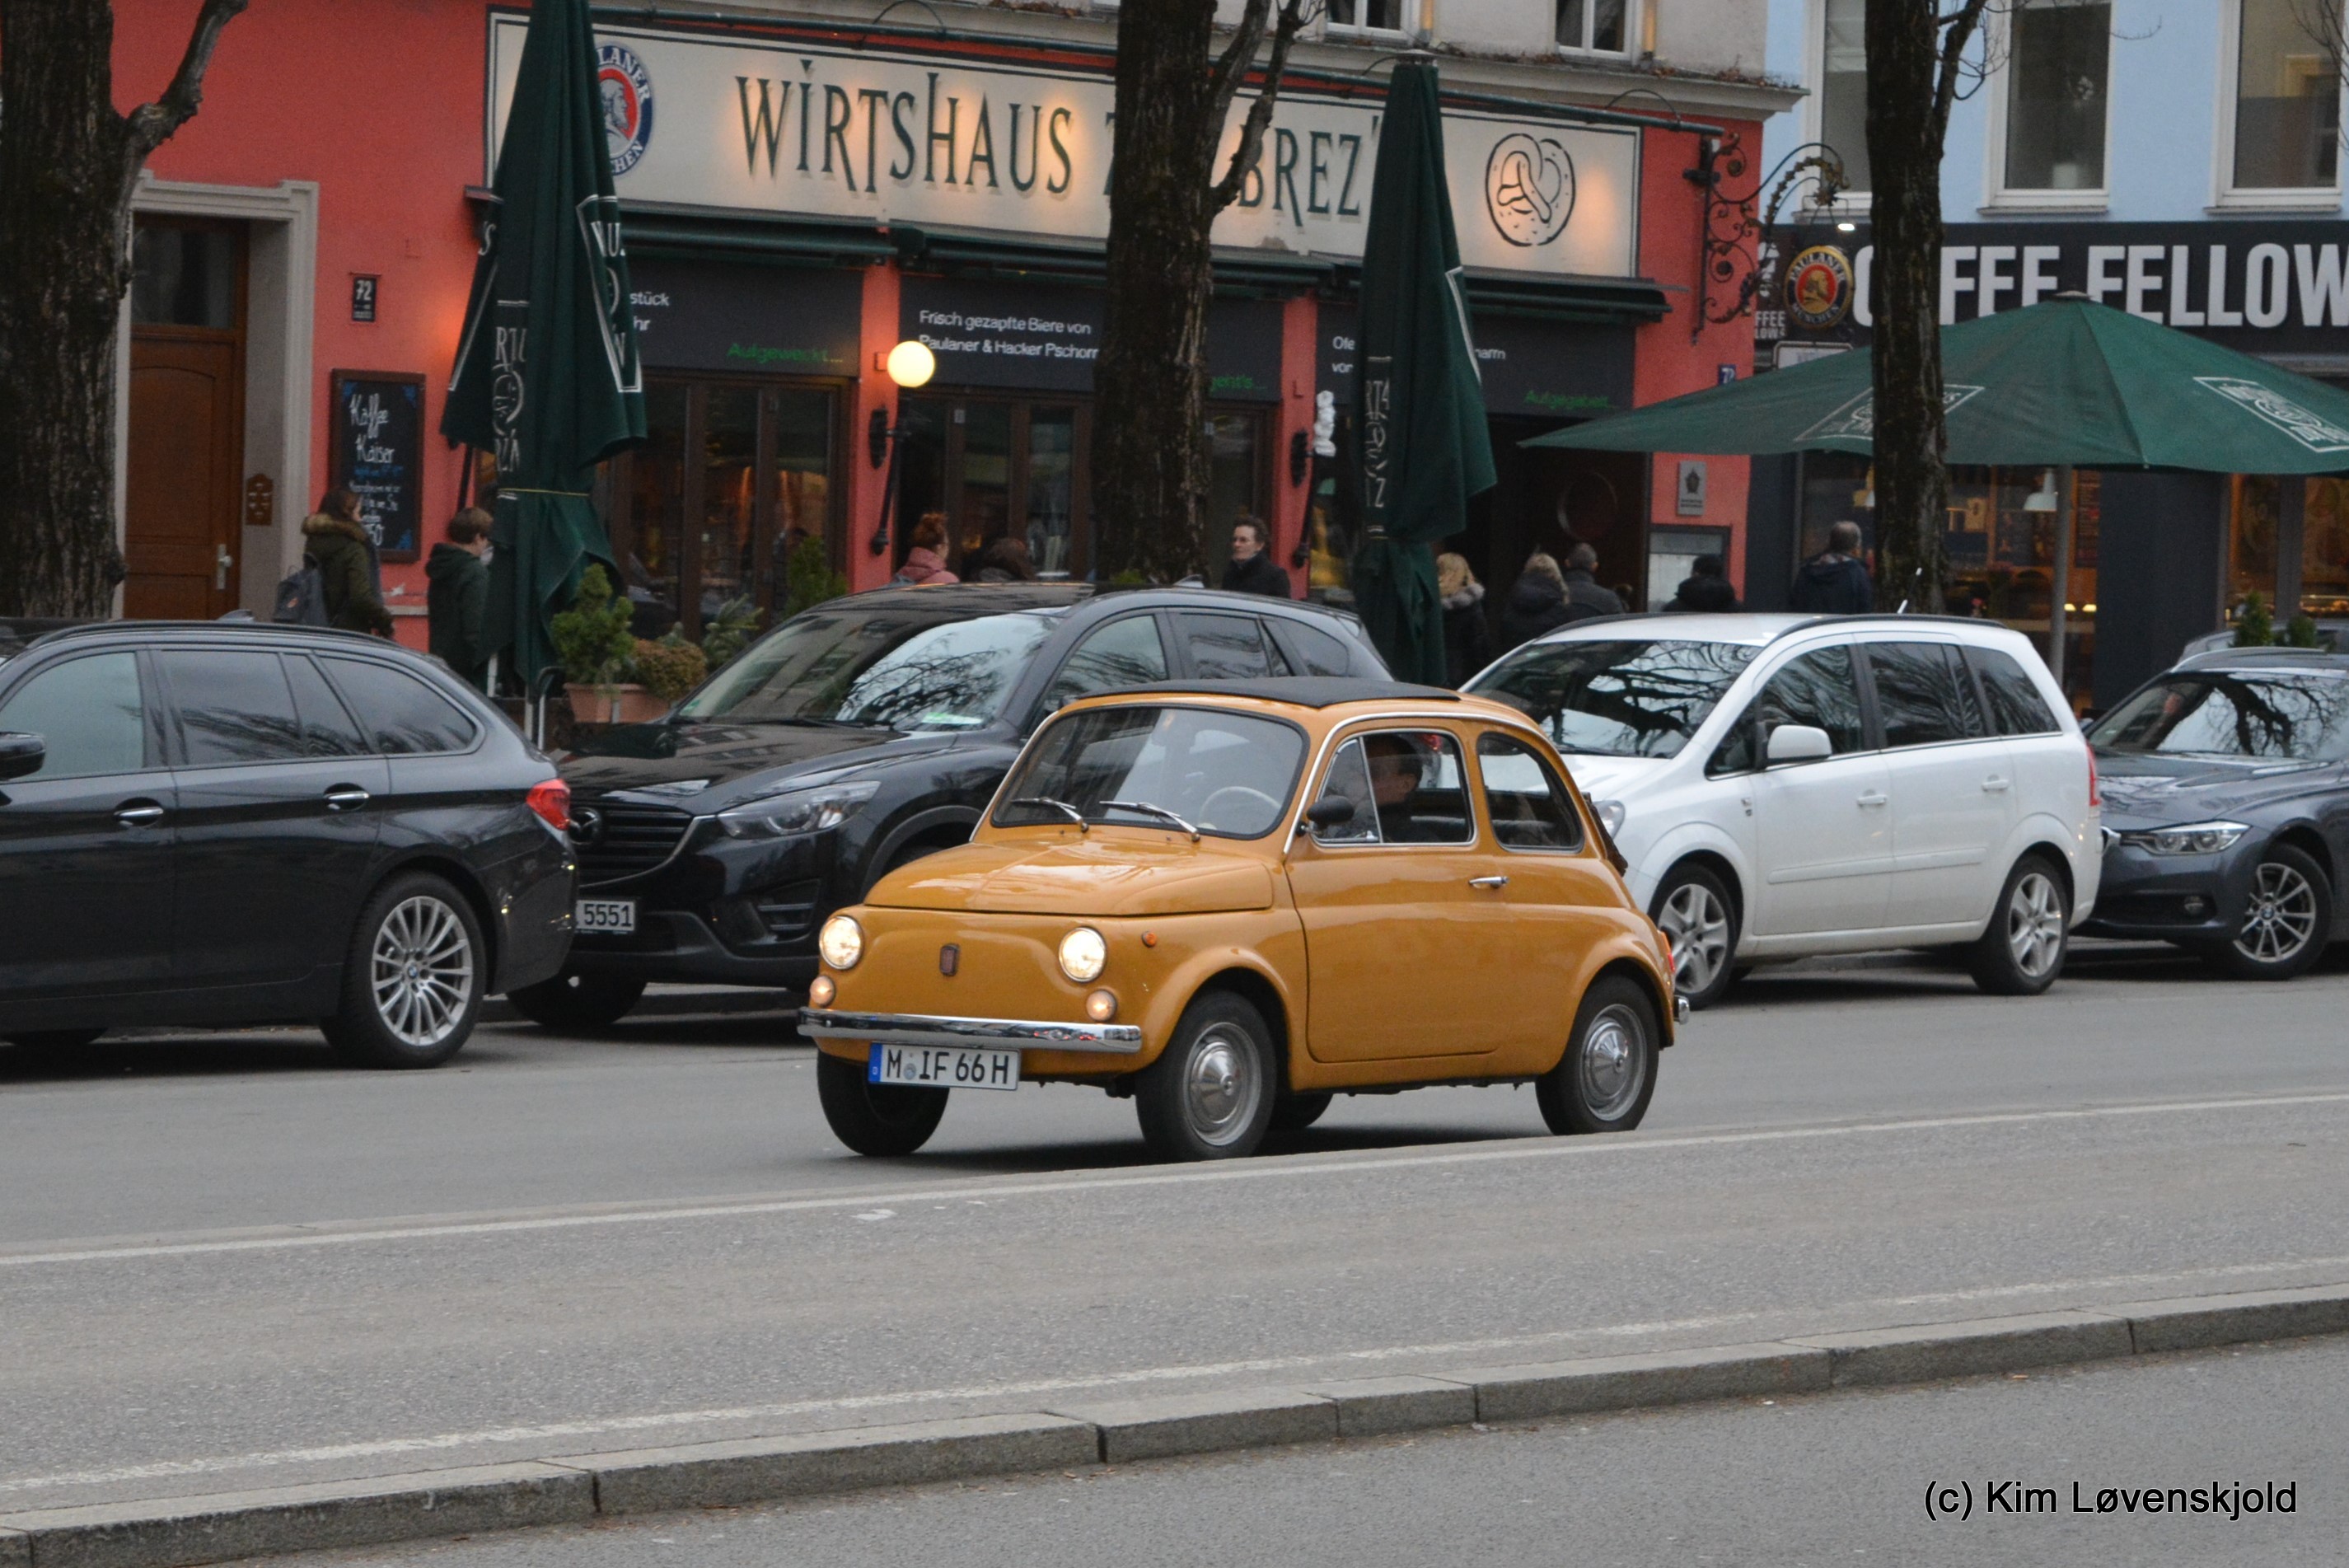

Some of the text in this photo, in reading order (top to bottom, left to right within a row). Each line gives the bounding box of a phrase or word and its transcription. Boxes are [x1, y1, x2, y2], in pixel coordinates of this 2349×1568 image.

[735, 59, 1072, 194] WIRTSHAUS
[356, 280, 372, 301] 72
[919, 310, 1092, 335] Frisch gezapfte Biere von
[919, 335, 1100, 358] Paulaner & Hacker Pschorr
[349, 393, 389, 438] Kaffee
[355, 433, 395, 464] Kaiser
[584, 903, 632, 927] 5551
